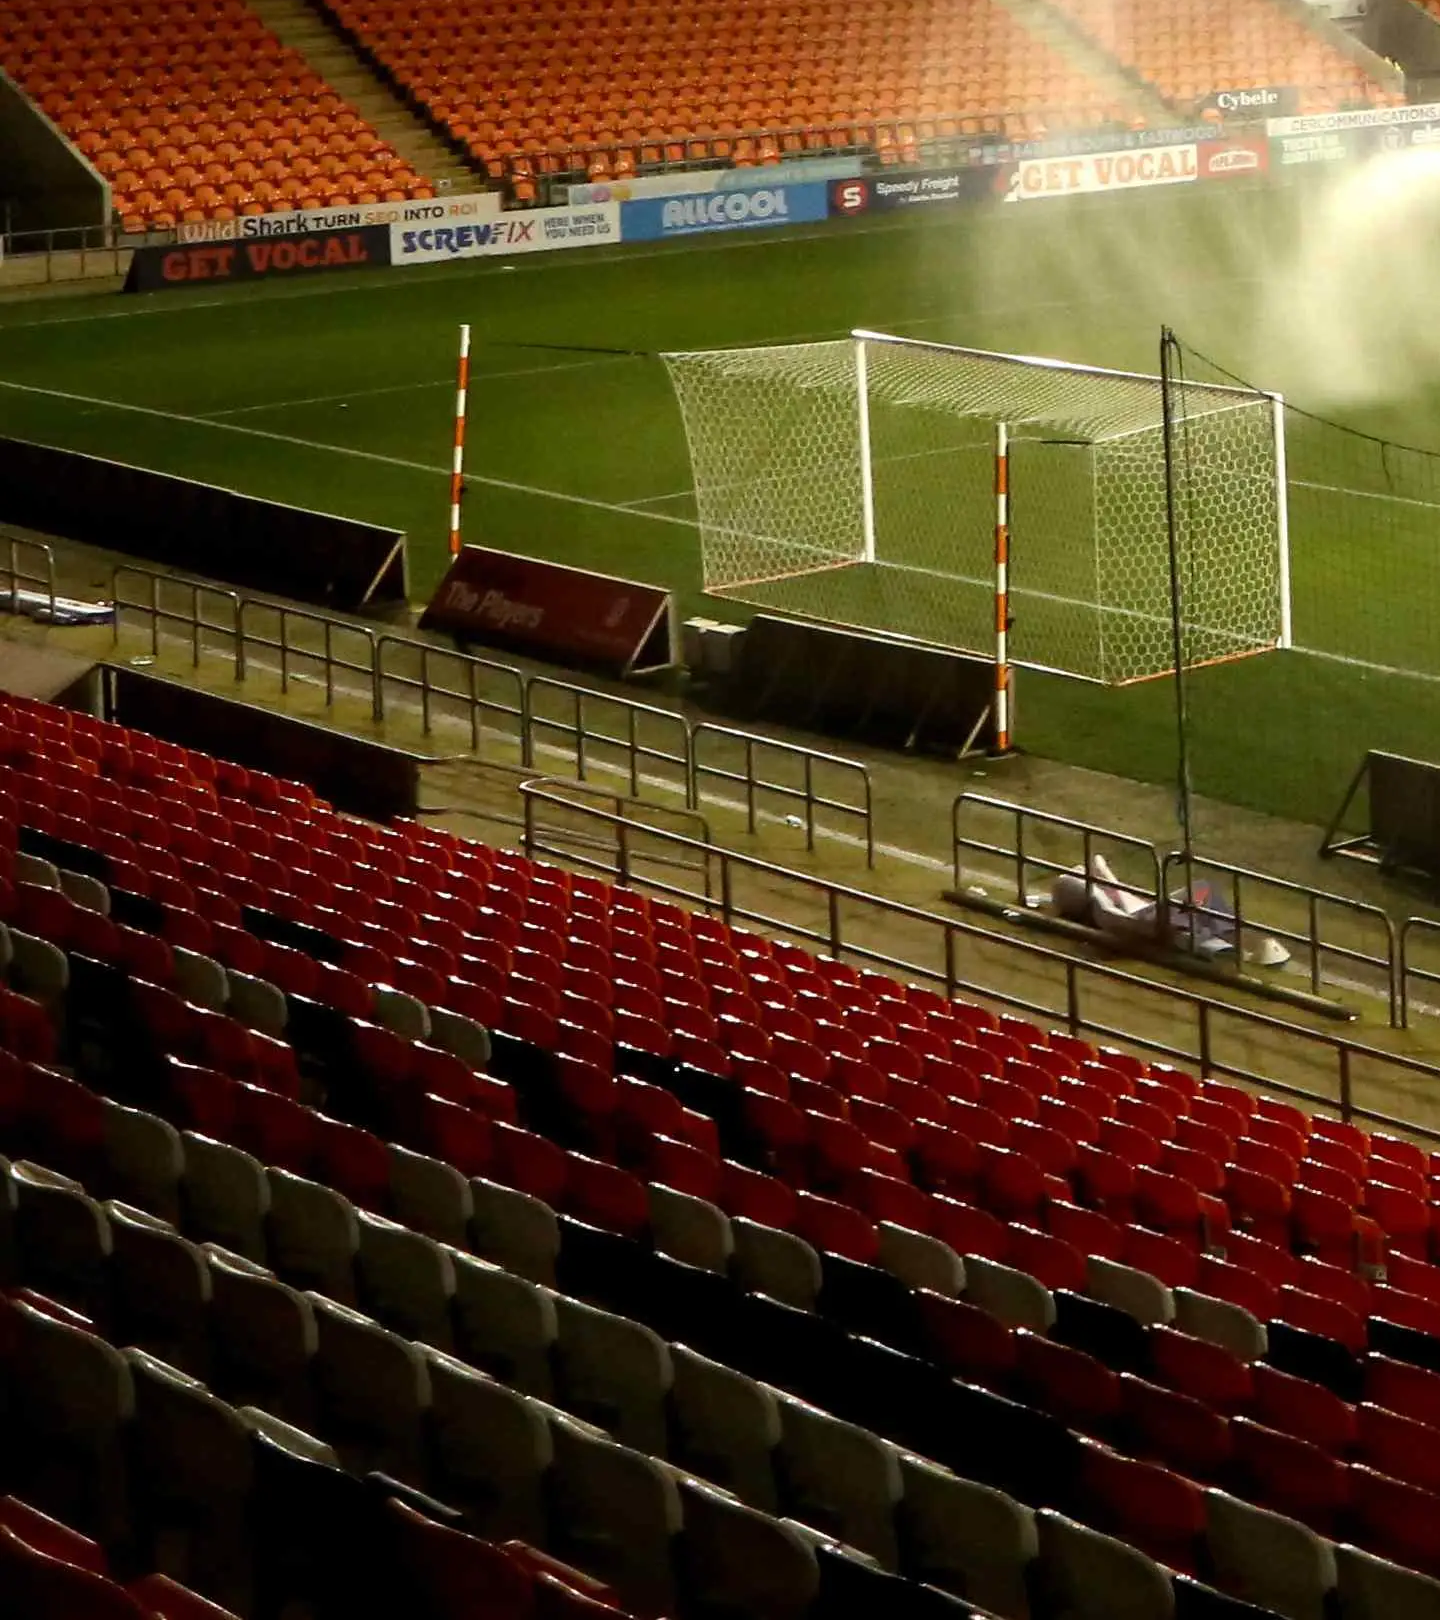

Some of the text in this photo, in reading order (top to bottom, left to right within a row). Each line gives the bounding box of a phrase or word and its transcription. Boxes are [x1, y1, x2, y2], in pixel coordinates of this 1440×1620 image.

[1217, 90, 1278, 110] Cybele
[1021, 160, 1083, 194] GET
[1094, 149, 1197, 185] VOCAL
[841, 186, 861, 208] S
[243, 213, 309, 237] Shark
[312, 212, 361, 229] TURN
[364, 210, 399, 225] SEO
[404, 206, 445, 221] INTO
[450, 203, 478, 216] ROI
[402, 219, 536, 253] SCREWFIX
[568, 225, 597, 238] NEED
[162, 235, 370, 281] GET VOCAL
[446, 580, 479, 612] The
